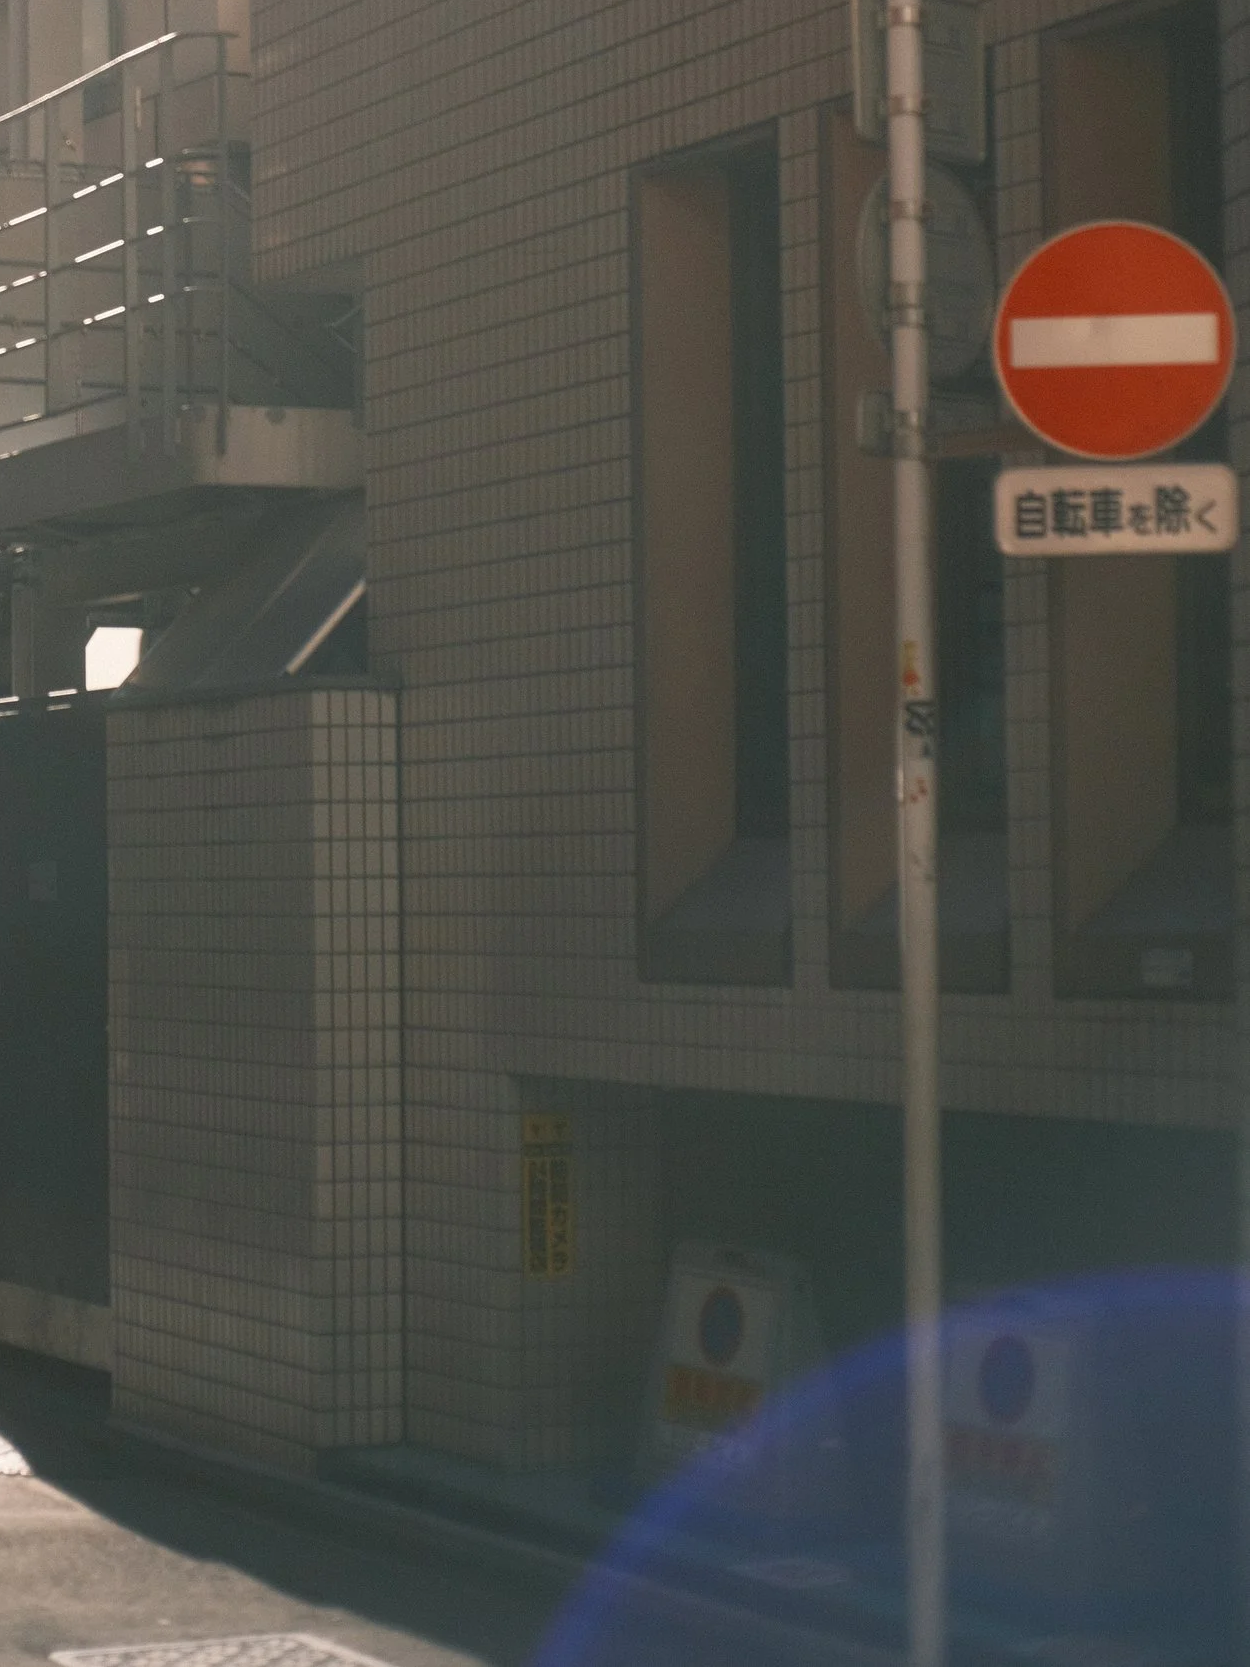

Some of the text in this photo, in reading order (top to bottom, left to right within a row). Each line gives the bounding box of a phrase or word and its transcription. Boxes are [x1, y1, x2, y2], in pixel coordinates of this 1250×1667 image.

[1014, 484, 1218, 540] 自転車を除く
